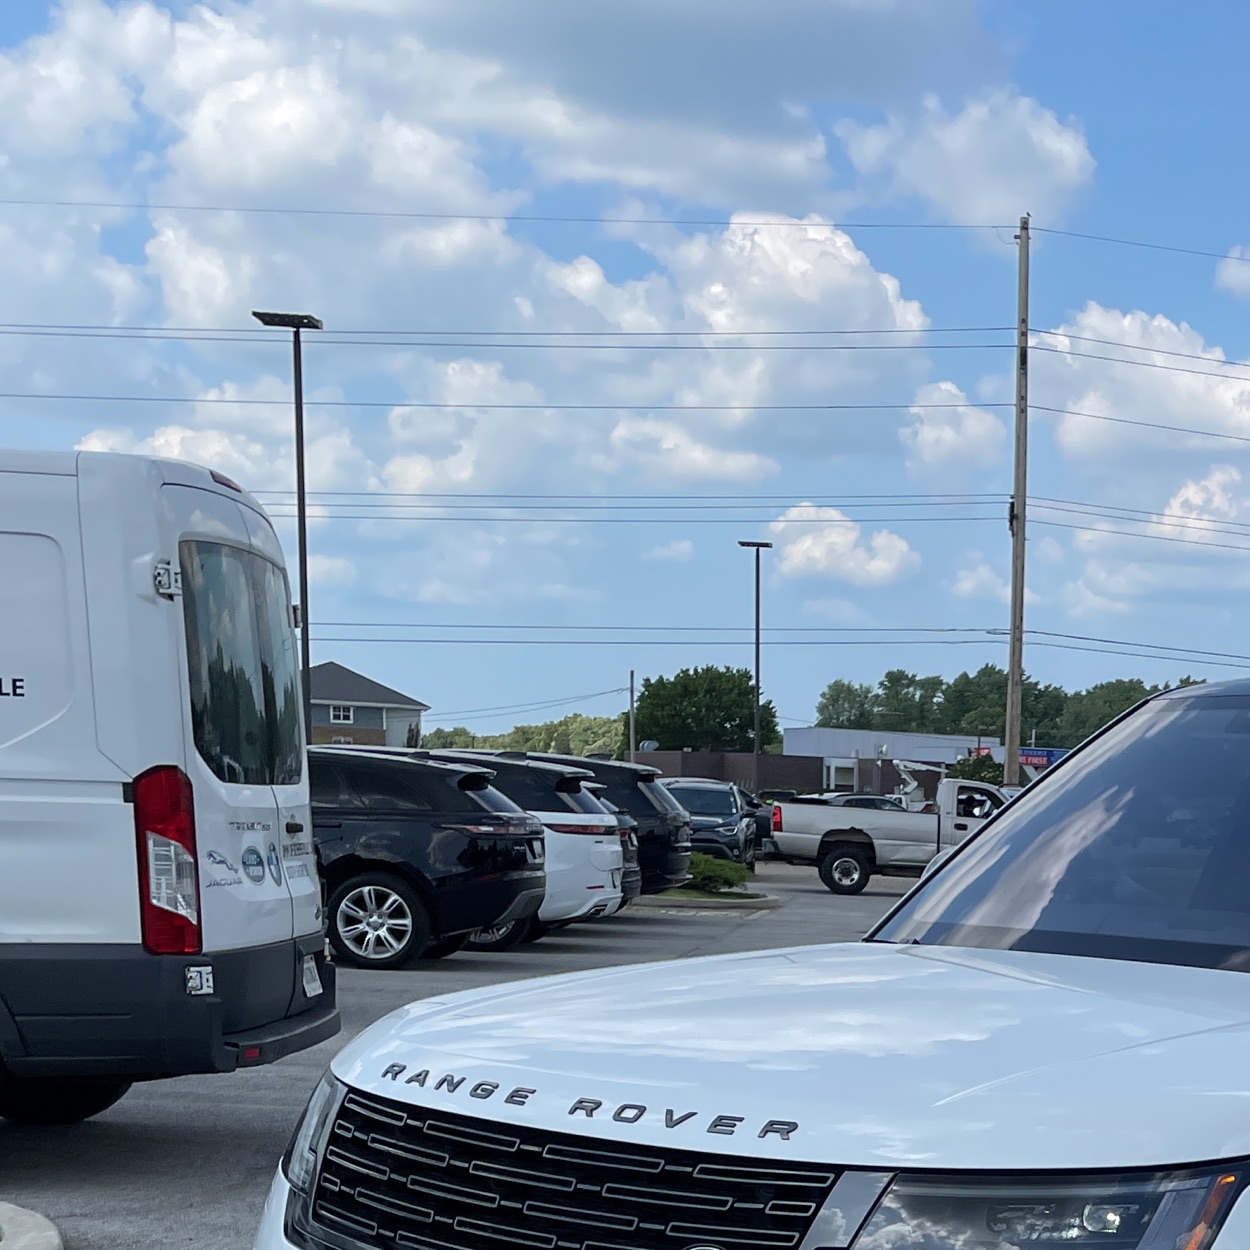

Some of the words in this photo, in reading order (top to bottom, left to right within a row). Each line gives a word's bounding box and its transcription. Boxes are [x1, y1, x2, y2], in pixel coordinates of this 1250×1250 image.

[0, 677, 25, 697] LE
[205, 879, 243, 888] JAGUAR
[381, 1062, 537, 1106] RANGE
[568, 1097, 799, 1141] ROVER
